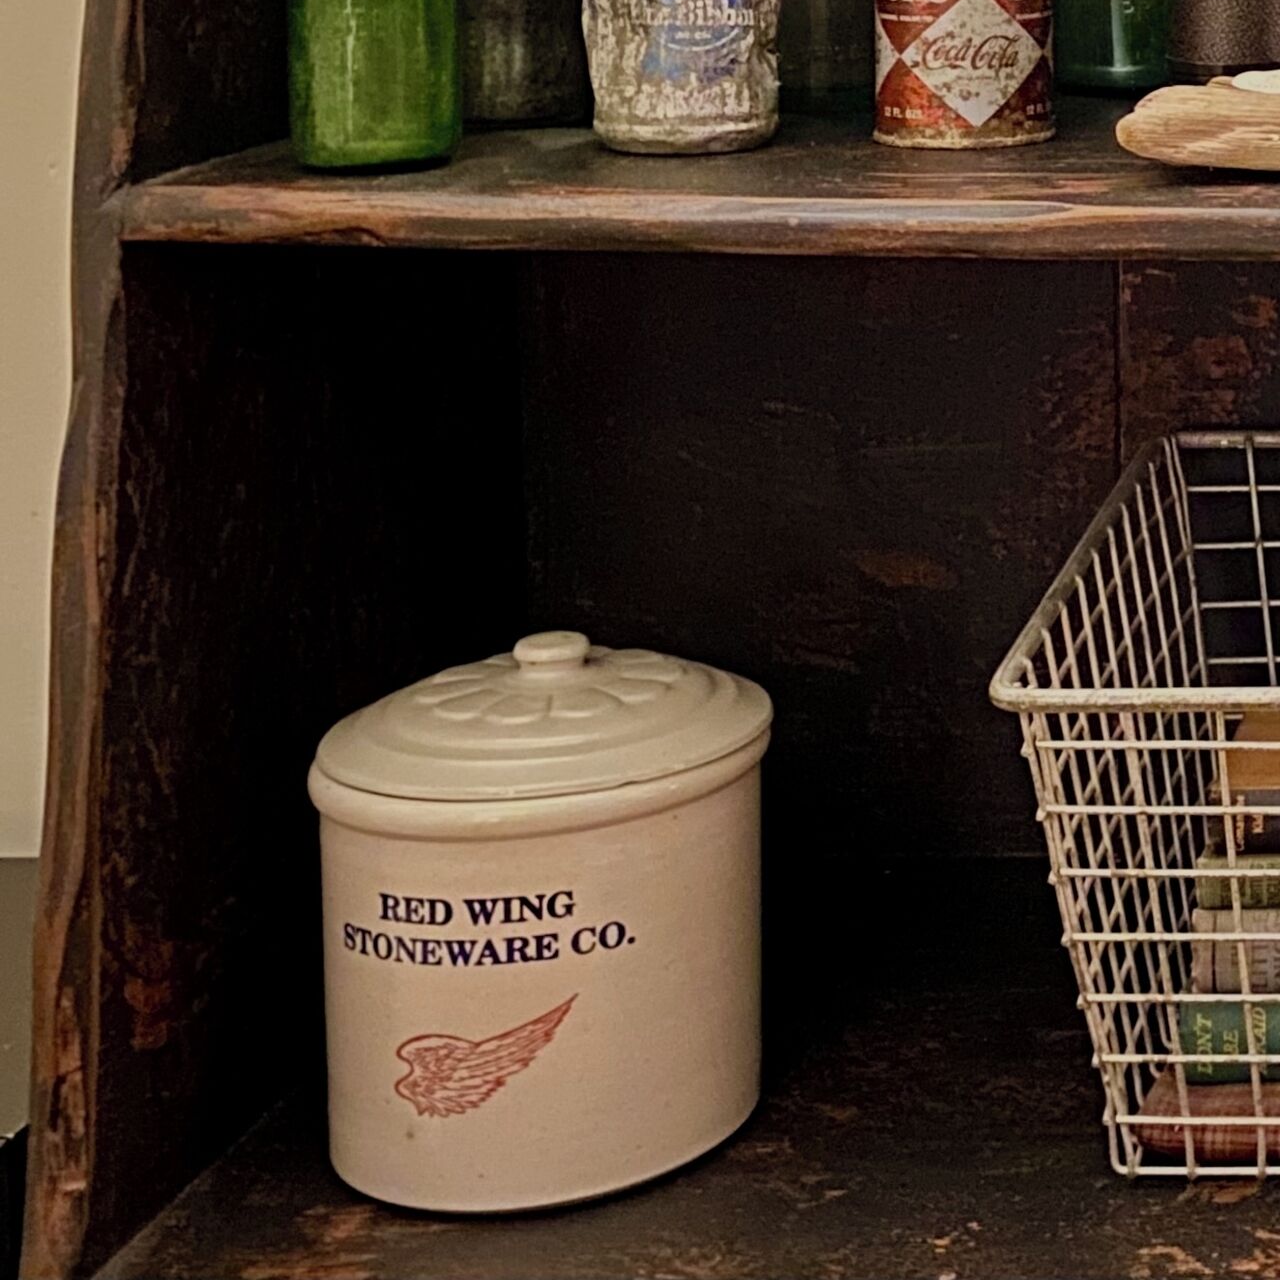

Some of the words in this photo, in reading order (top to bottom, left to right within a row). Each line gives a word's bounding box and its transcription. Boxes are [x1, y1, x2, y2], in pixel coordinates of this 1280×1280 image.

[379, 892, 453, 926] RED
[463, 890, 576, 927] WING
[343, 922, 560, 967] STONEWARE
[571, 921, 636, 956] CO.
[1193, 1012, 1213, 1075] DON'T
